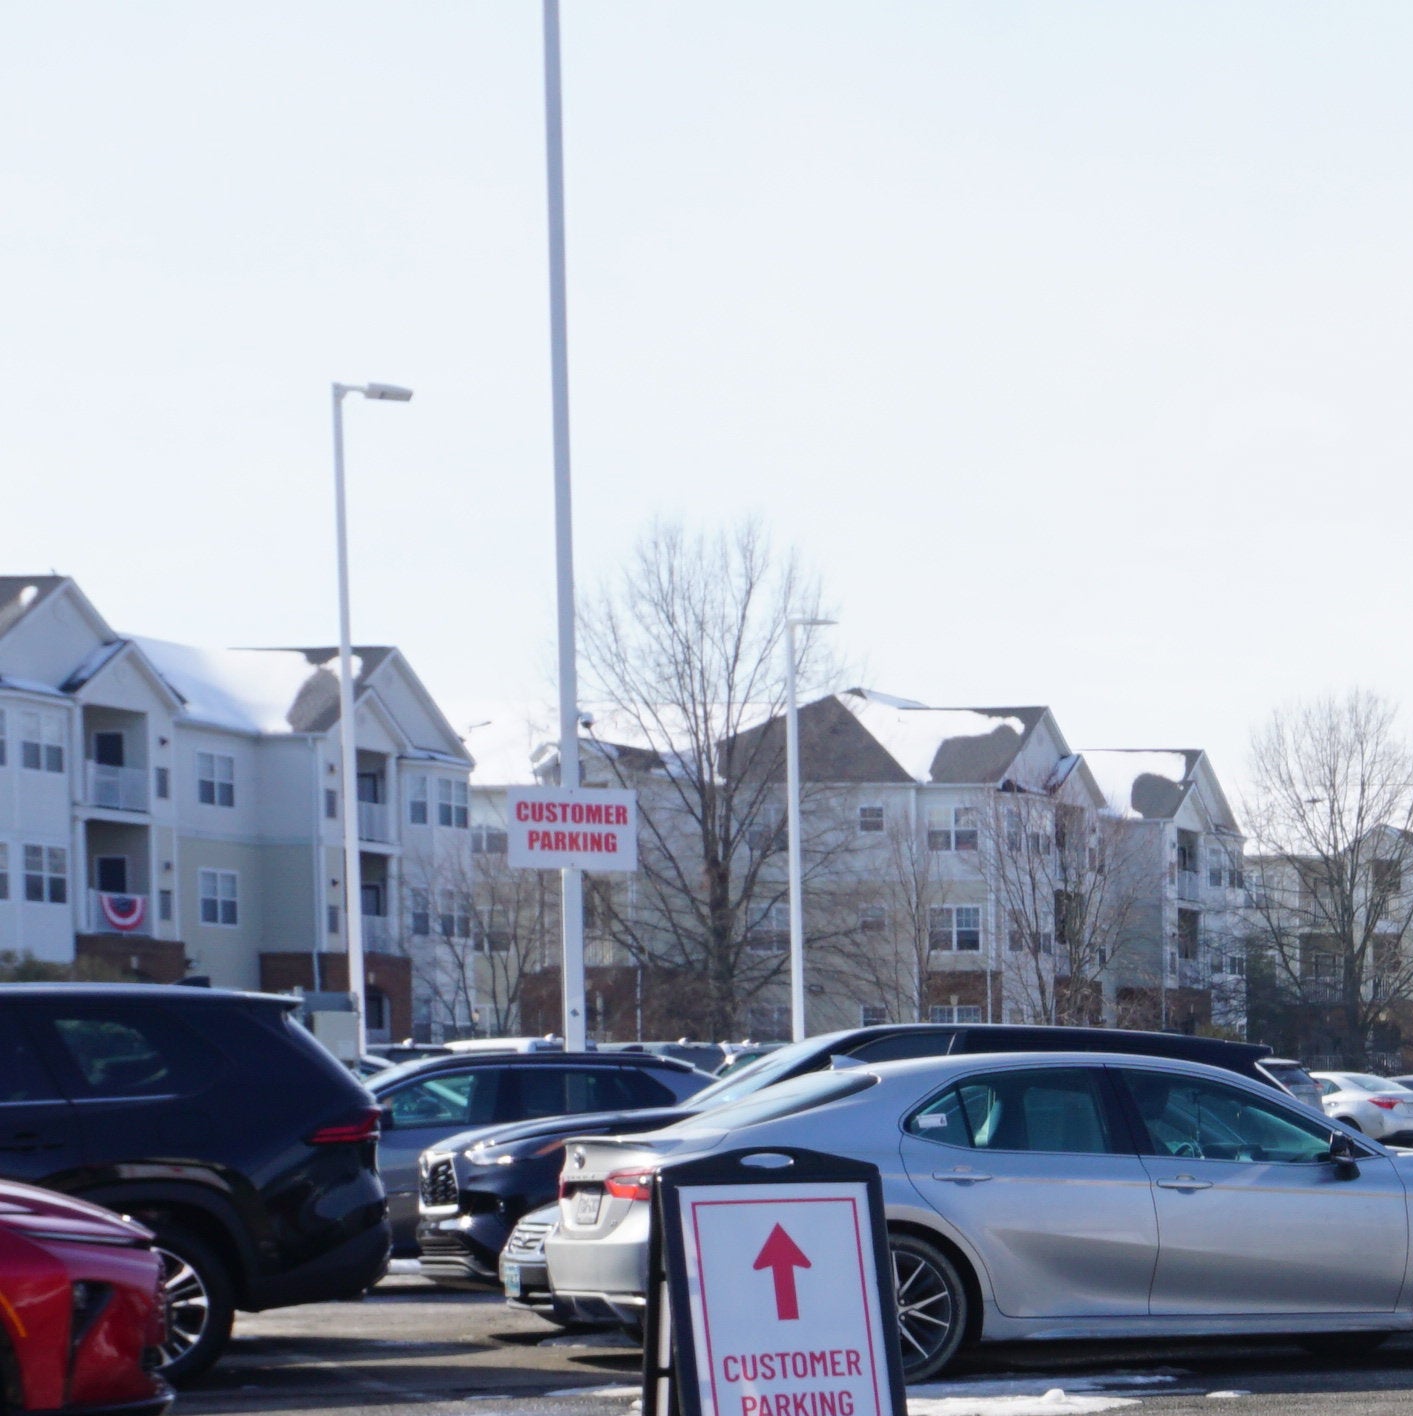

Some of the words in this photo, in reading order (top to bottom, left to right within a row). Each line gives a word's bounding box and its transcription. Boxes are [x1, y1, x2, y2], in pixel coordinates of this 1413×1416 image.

[516, 801, 628, 825] CUSTOMER
[527, 830, 617, 853] PARKING
[723, 1349, 863, 1383] CUSTOMER
